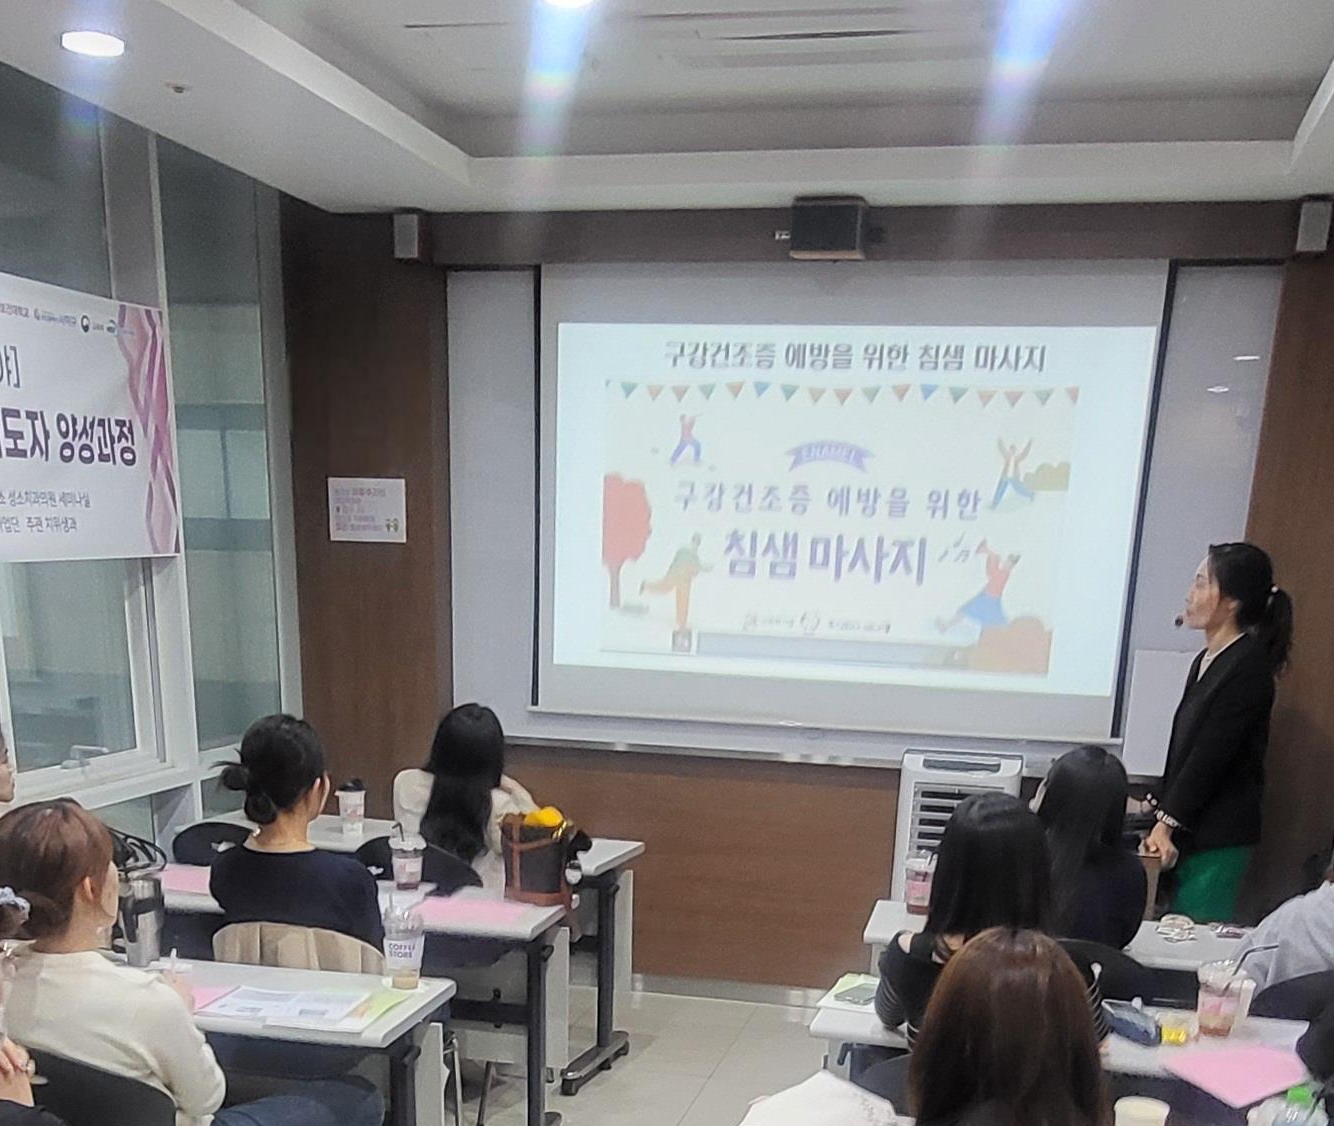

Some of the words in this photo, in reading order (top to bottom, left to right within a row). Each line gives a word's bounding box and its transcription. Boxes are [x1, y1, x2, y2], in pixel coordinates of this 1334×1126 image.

[664, 340, 777, 370] 구강건조증
[785, 342, 854, 371] 예방을
[863, 343, 909, 372] 위한
[918, 344, 965, 373] 침샘
[974, 345, 1046, 374] 마사지
[56, 414, 138, 467] 양성과정
[674, 480, 812, 516] 구강건조증
[827, 484, 910, 519] 예방을
[927, 487, 982, 521] 위한
[26, 515, 45, 533] 주관
[724, 529, 799, 580] 침샘
[809, 534, 927, 585] 마사지
